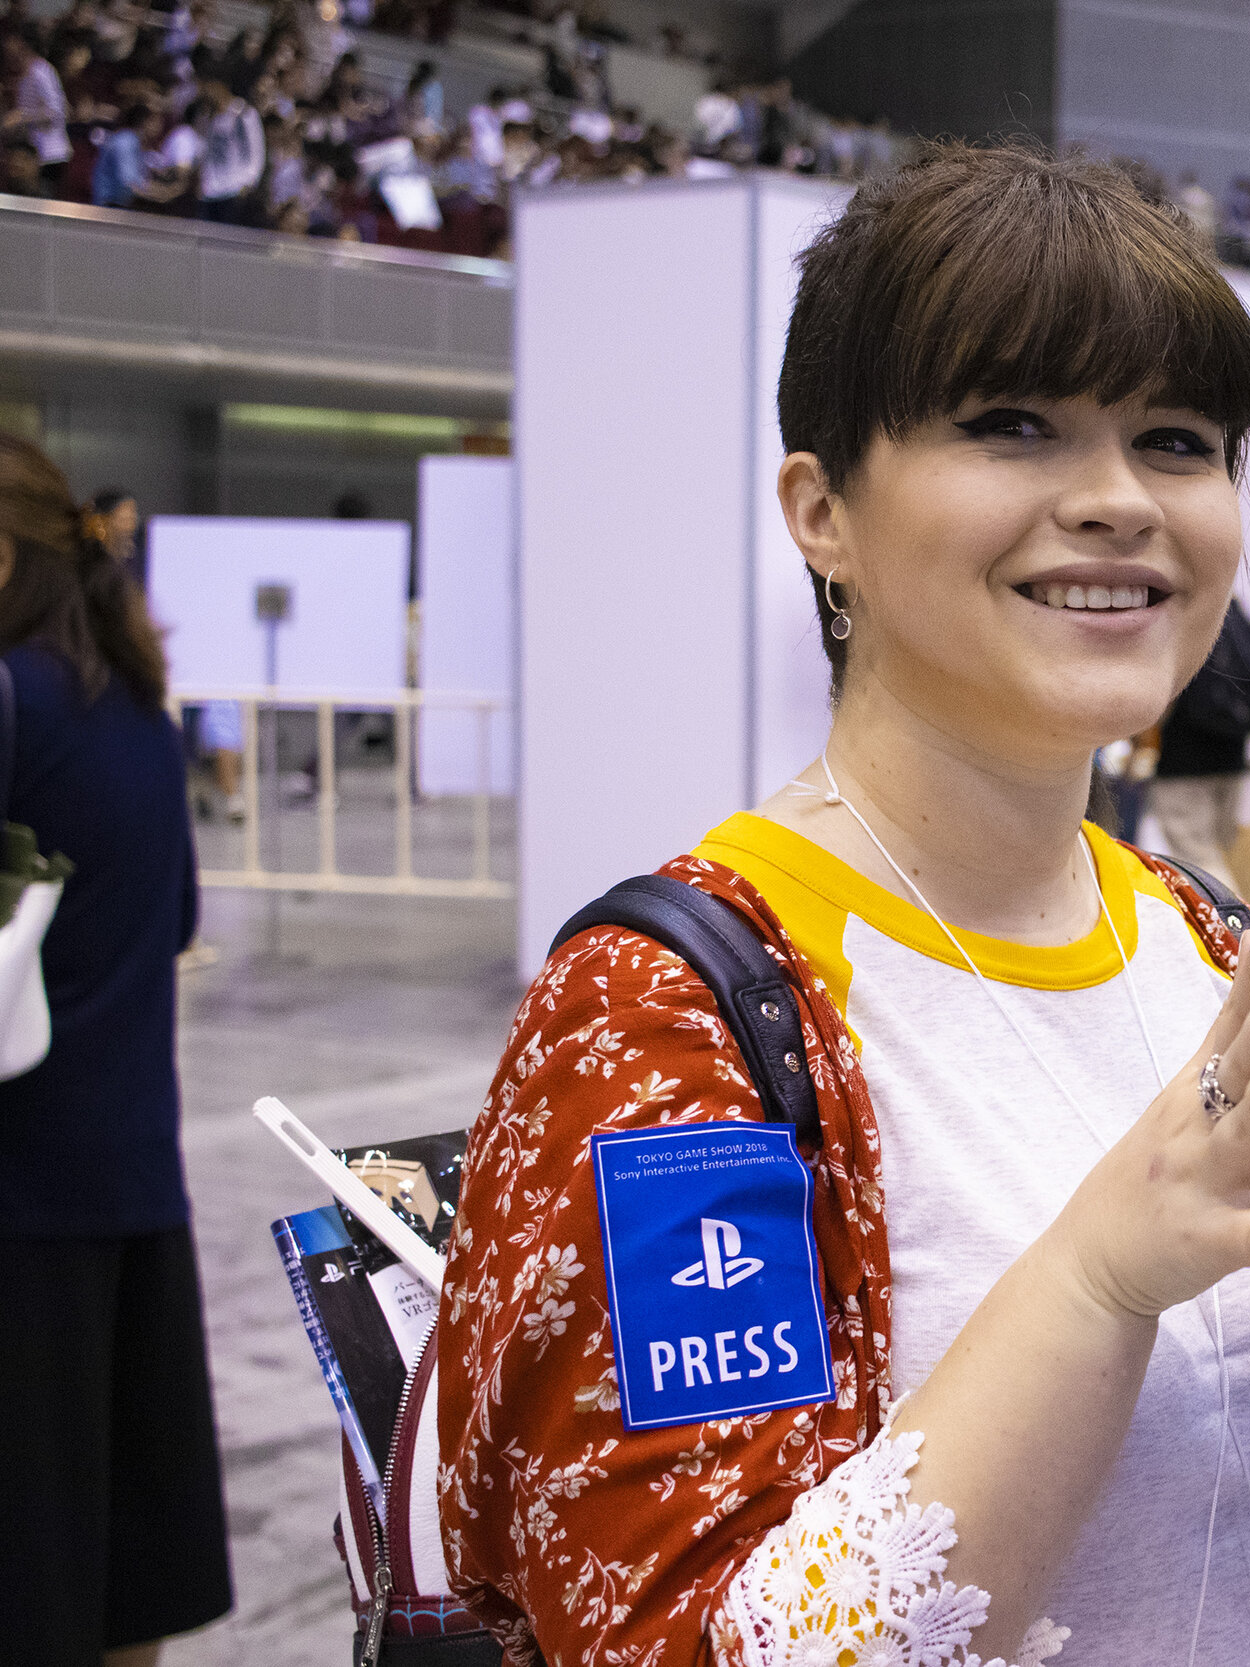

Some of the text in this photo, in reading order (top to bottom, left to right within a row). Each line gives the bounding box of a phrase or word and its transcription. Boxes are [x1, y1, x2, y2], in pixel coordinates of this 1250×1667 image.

[635, 1143, 768, 1165] TOKYO GAME SHOW 2018
[614, 1170, 641, 1181] Sony
[643, 1163, 700, 1177] Interactive
[702, 1156, 775, 1170] Entertainment
[649, 1321, 799, 1392] PRESS
